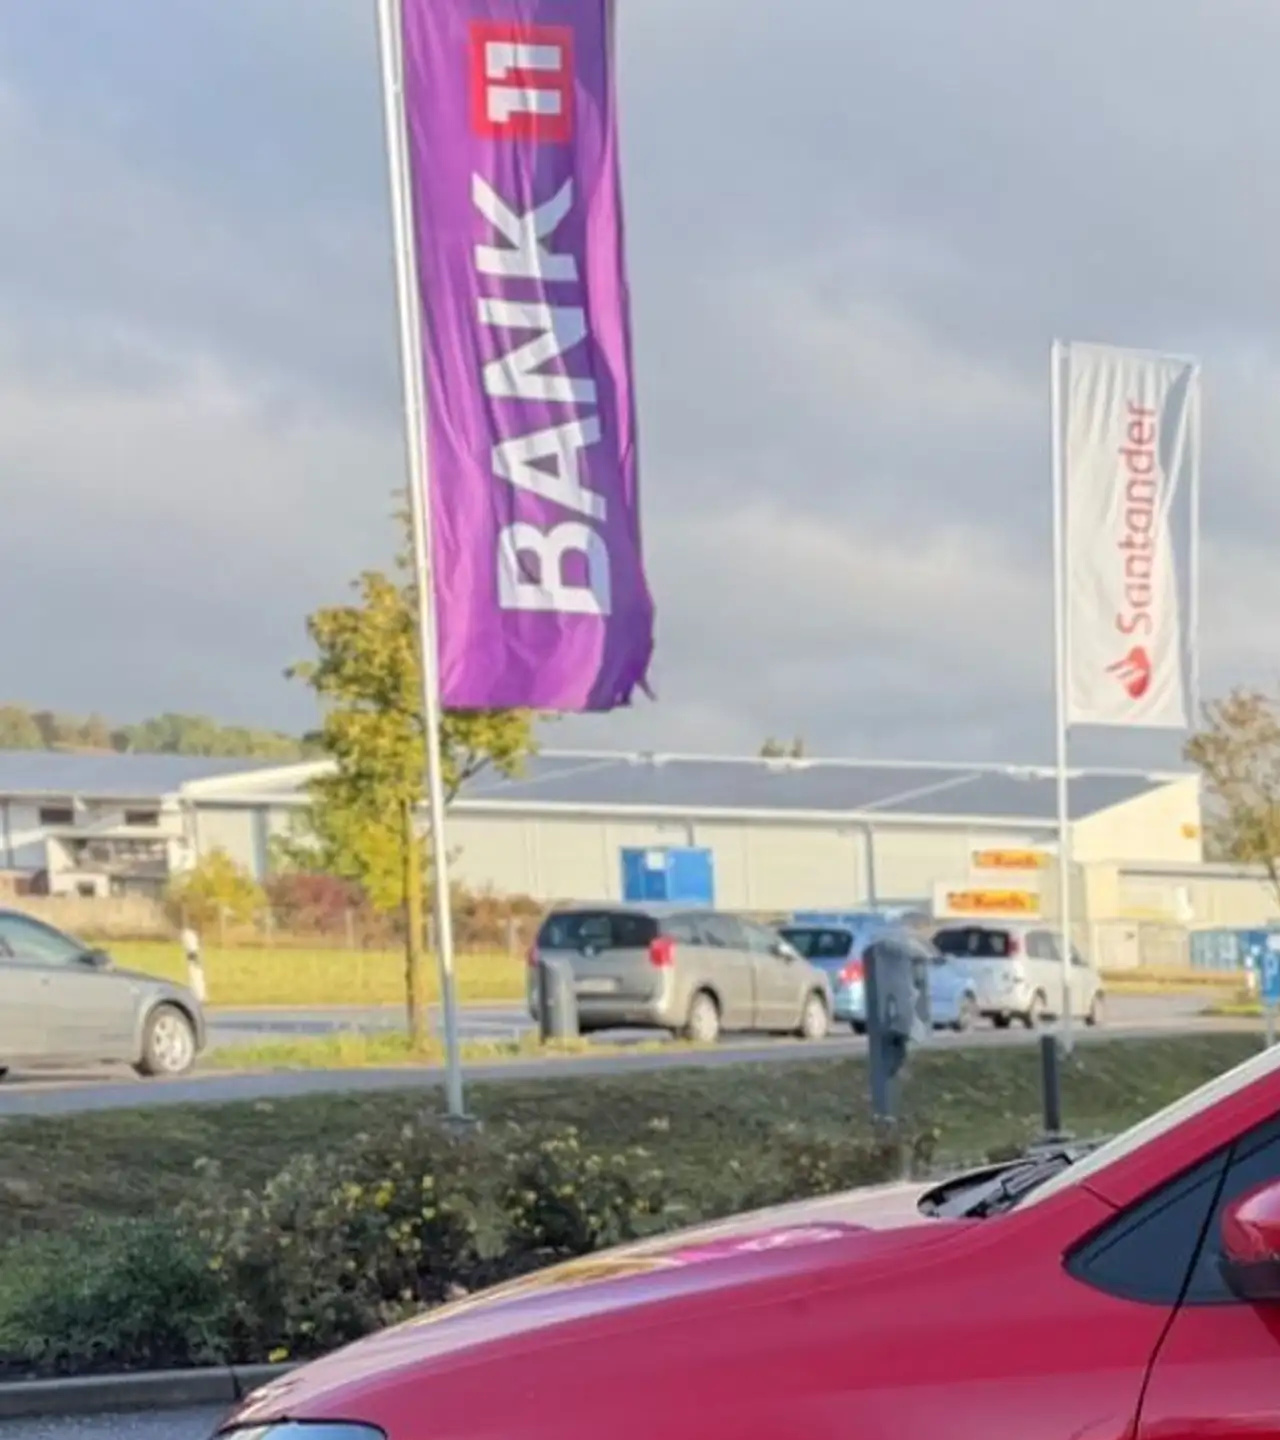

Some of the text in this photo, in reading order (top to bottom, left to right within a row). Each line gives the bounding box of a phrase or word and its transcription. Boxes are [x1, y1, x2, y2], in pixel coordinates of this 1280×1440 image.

[471, 41, 612, 615] BANK 11
[1115, 399, 1157, 635] Santander
